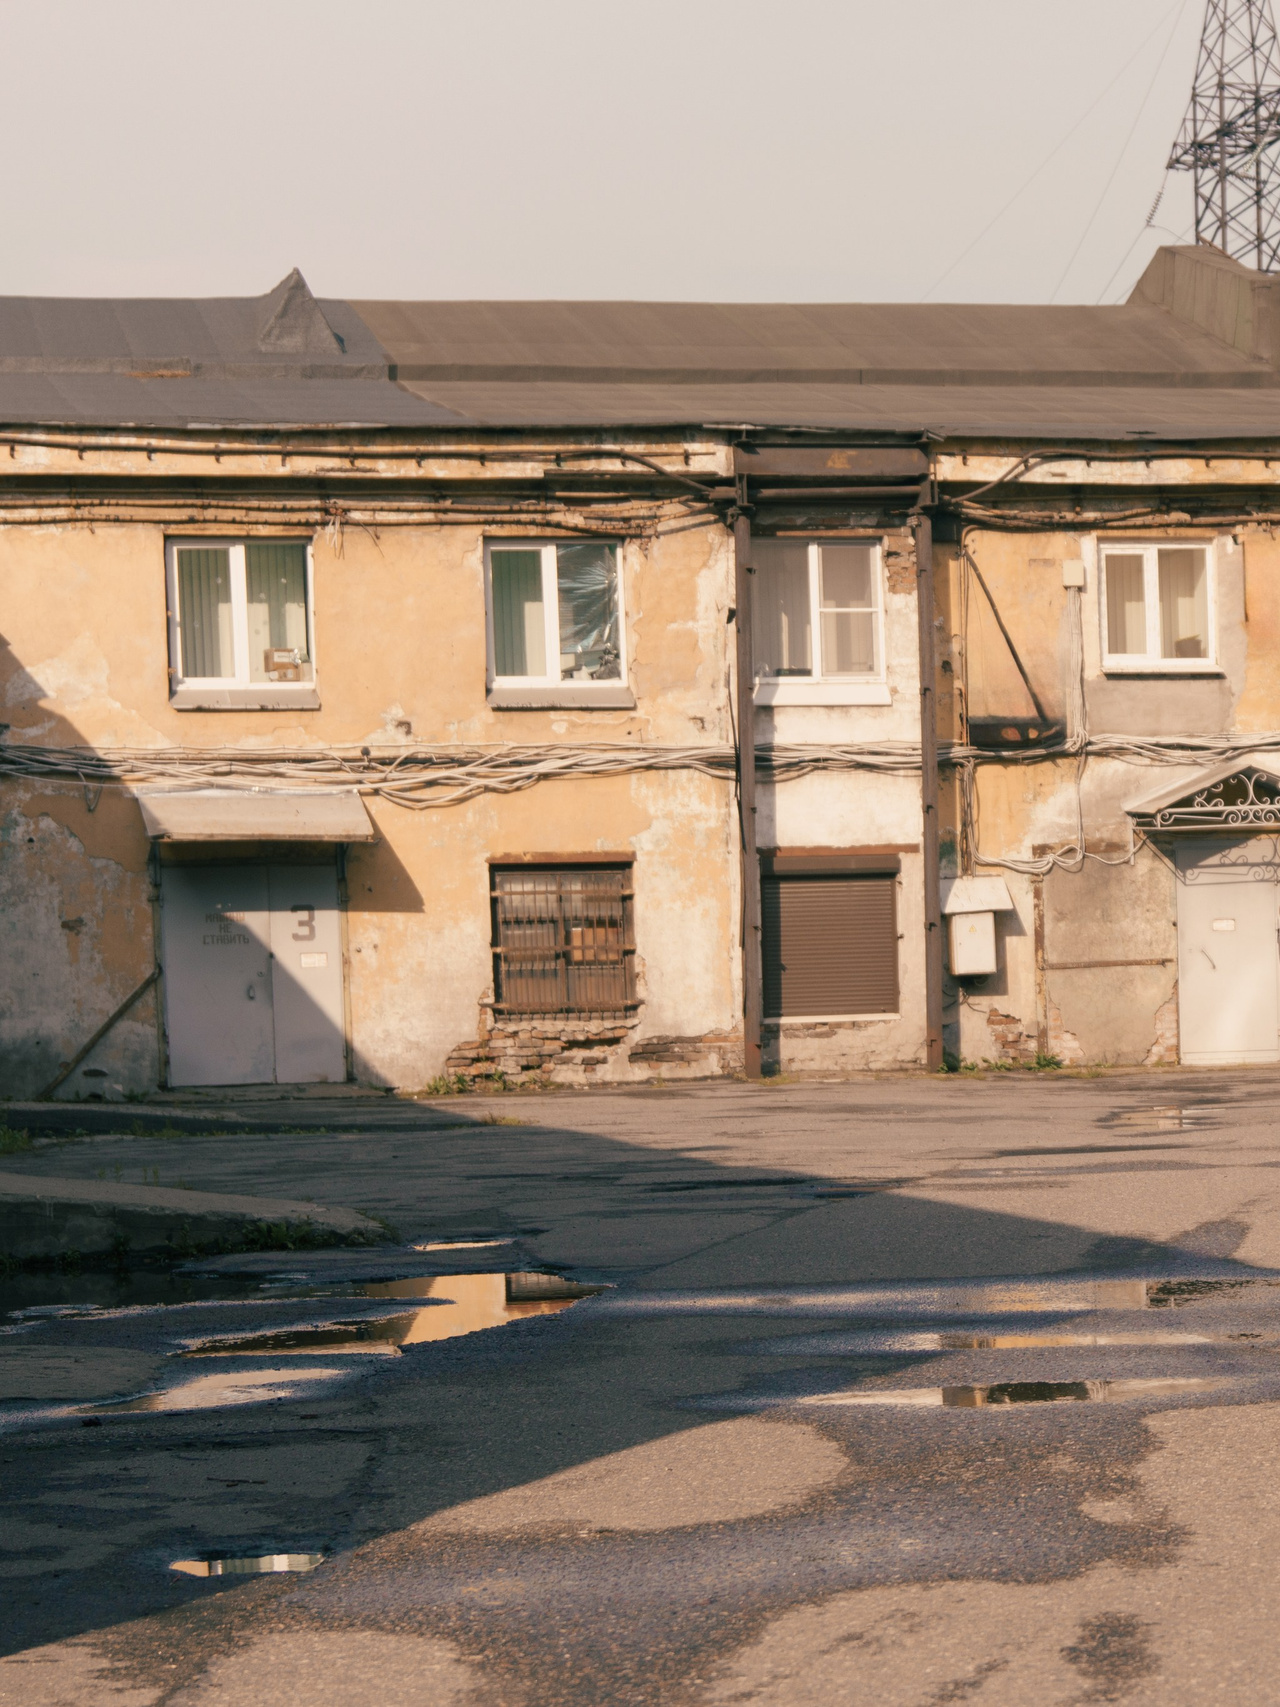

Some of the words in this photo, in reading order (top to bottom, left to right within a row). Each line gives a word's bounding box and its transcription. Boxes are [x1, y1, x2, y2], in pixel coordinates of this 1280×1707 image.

[218, 923, 232, 933] НЕ
[291, 904, 316, 941] 3
[203, 933, 250, 945] СТАВИТЬ
